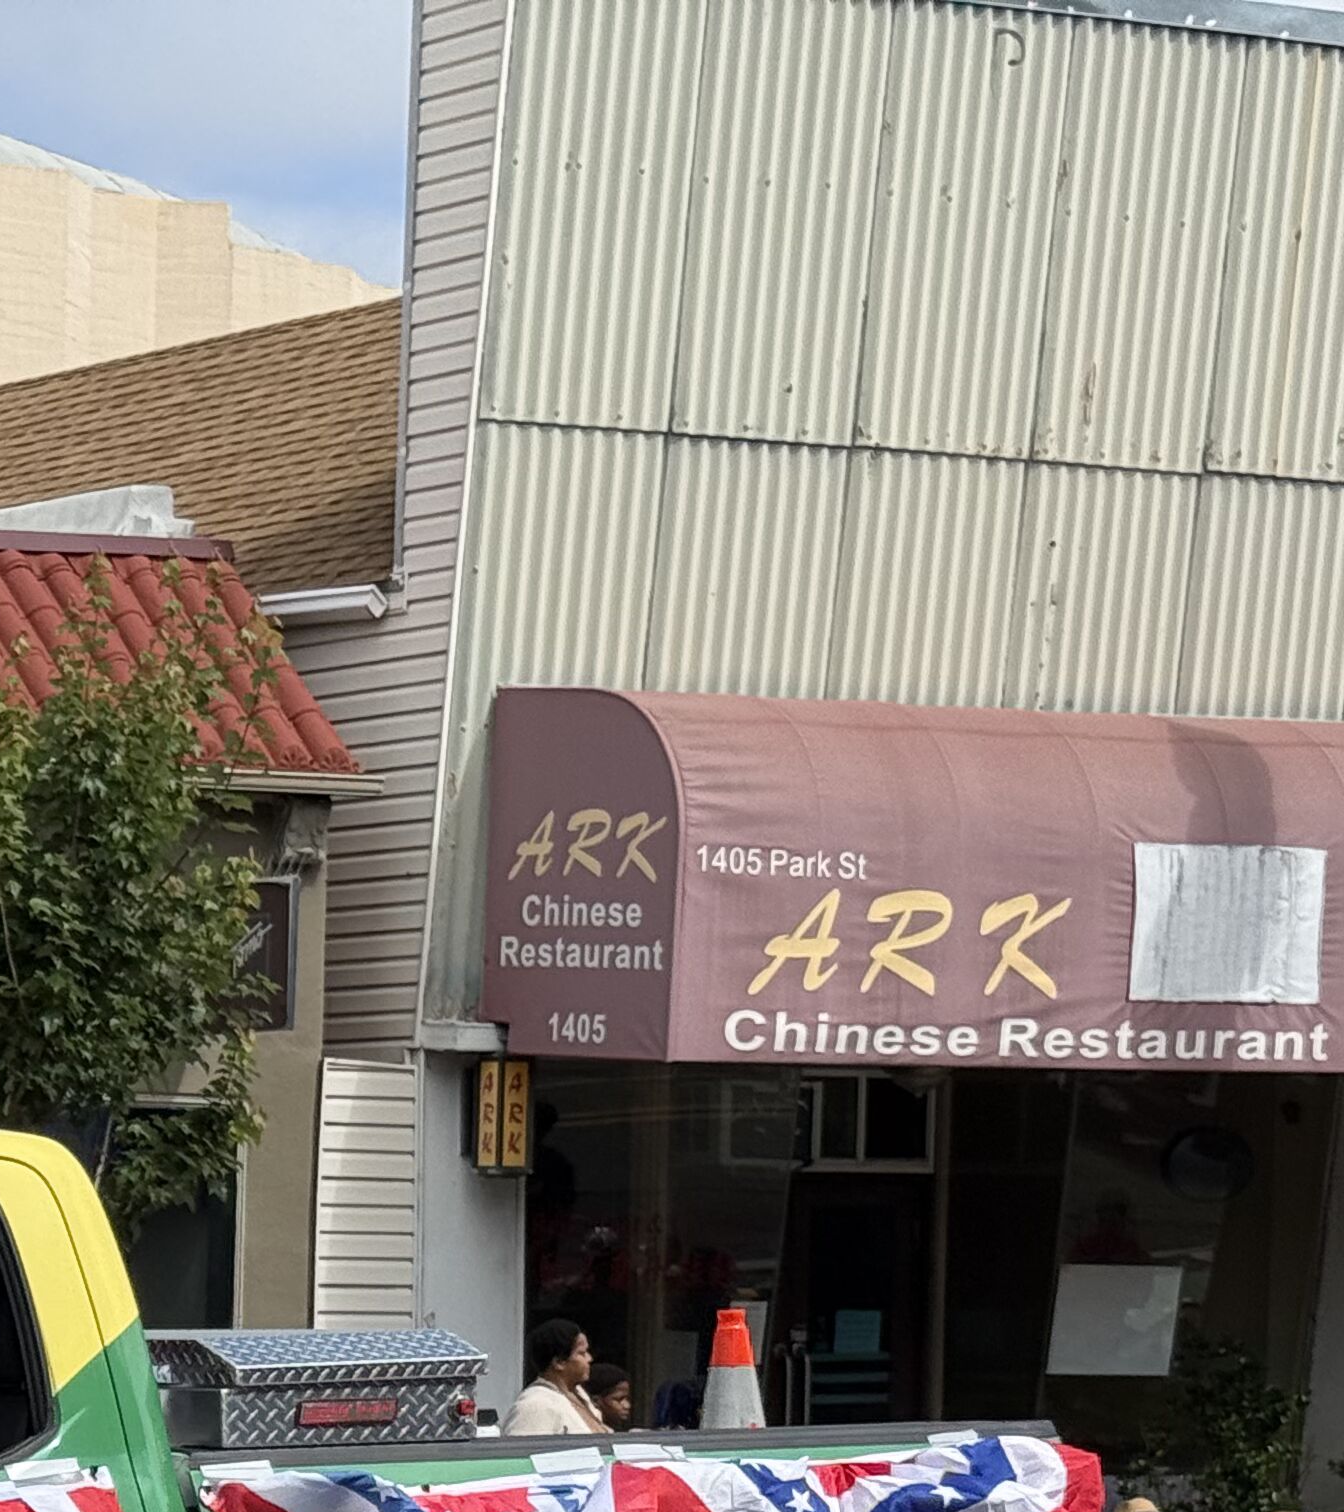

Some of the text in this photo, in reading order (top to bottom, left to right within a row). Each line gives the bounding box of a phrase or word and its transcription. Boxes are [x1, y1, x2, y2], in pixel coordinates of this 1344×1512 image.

[508, 808, 668, 884] ARK
[696, 845, 868, 881] 1405 Park St
[521, 893, 643, 928] Chinese
[499, 935, 664, 971] Restaurant
[747, 887, 1073, 1000] ARK
[548, 1011, 608, 1044] 1405
[723, 1008, 1330, 1062] Chinese Restaurant
